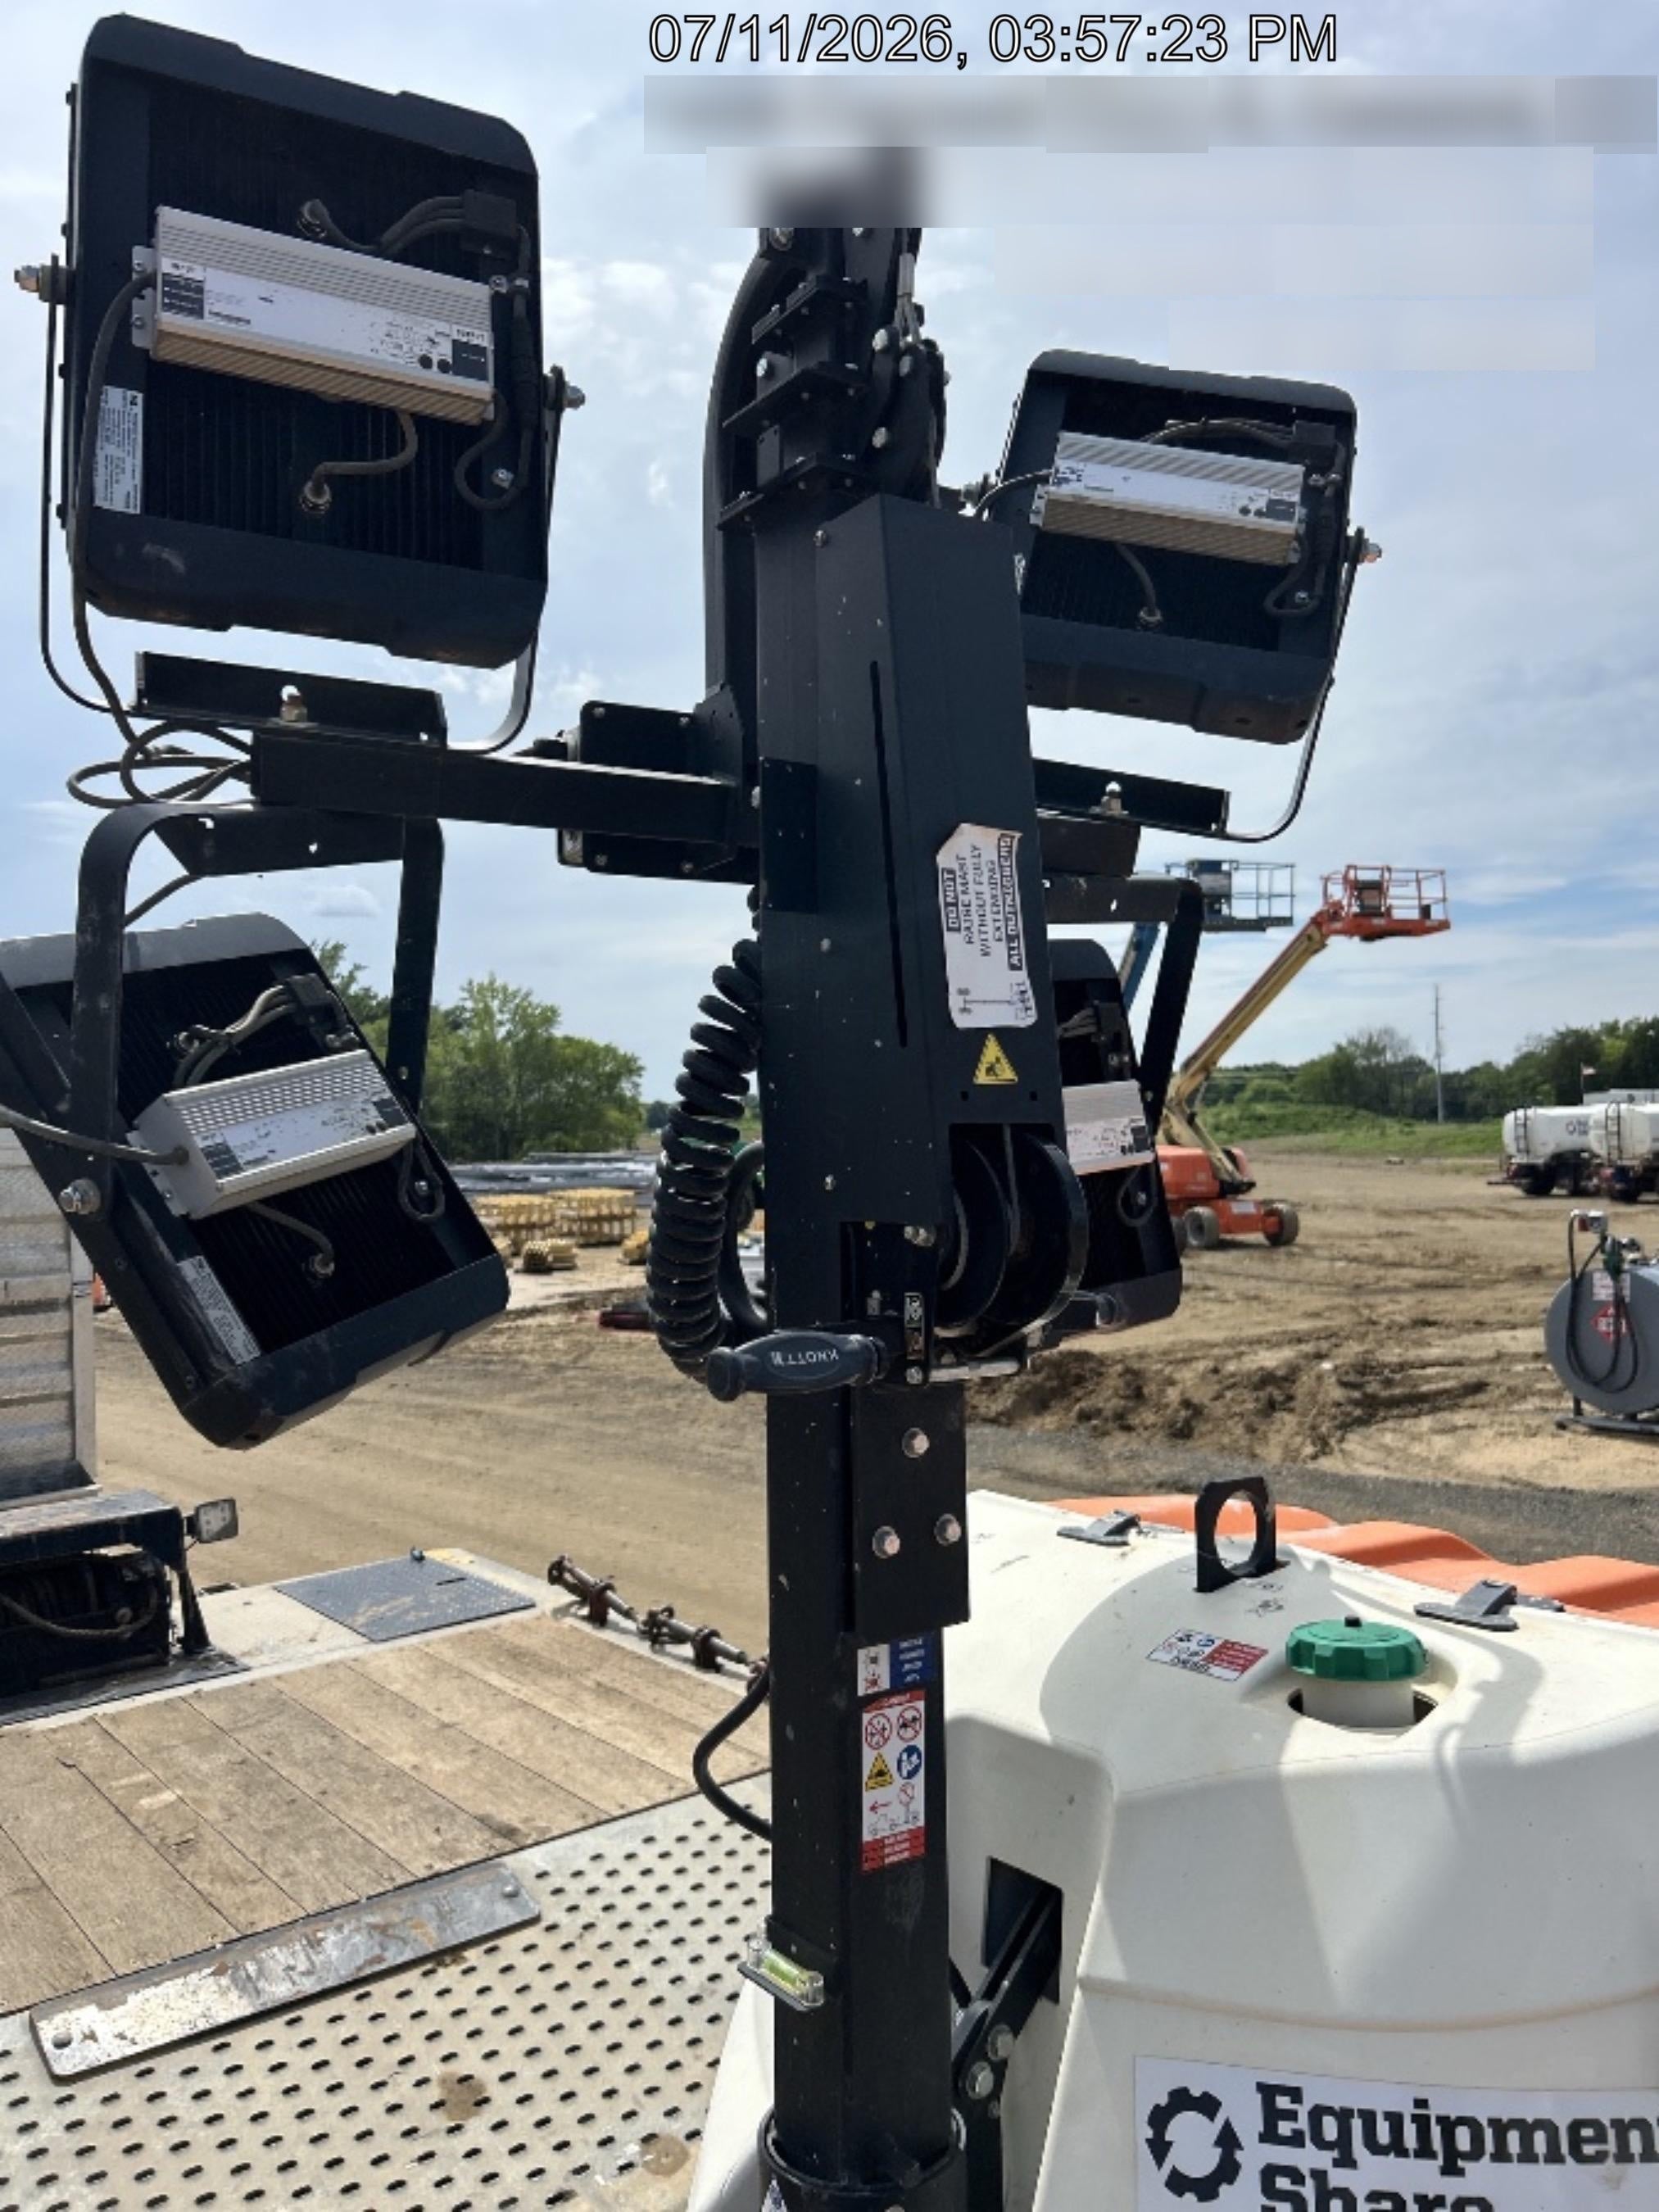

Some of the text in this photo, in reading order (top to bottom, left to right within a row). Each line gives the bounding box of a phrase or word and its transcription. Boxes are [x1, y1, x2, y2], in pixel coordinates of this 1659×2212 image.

[971, 844, 991, 957] WITHOUT FULLY
[1256, 2081, 1659, 2178] Equipmen
